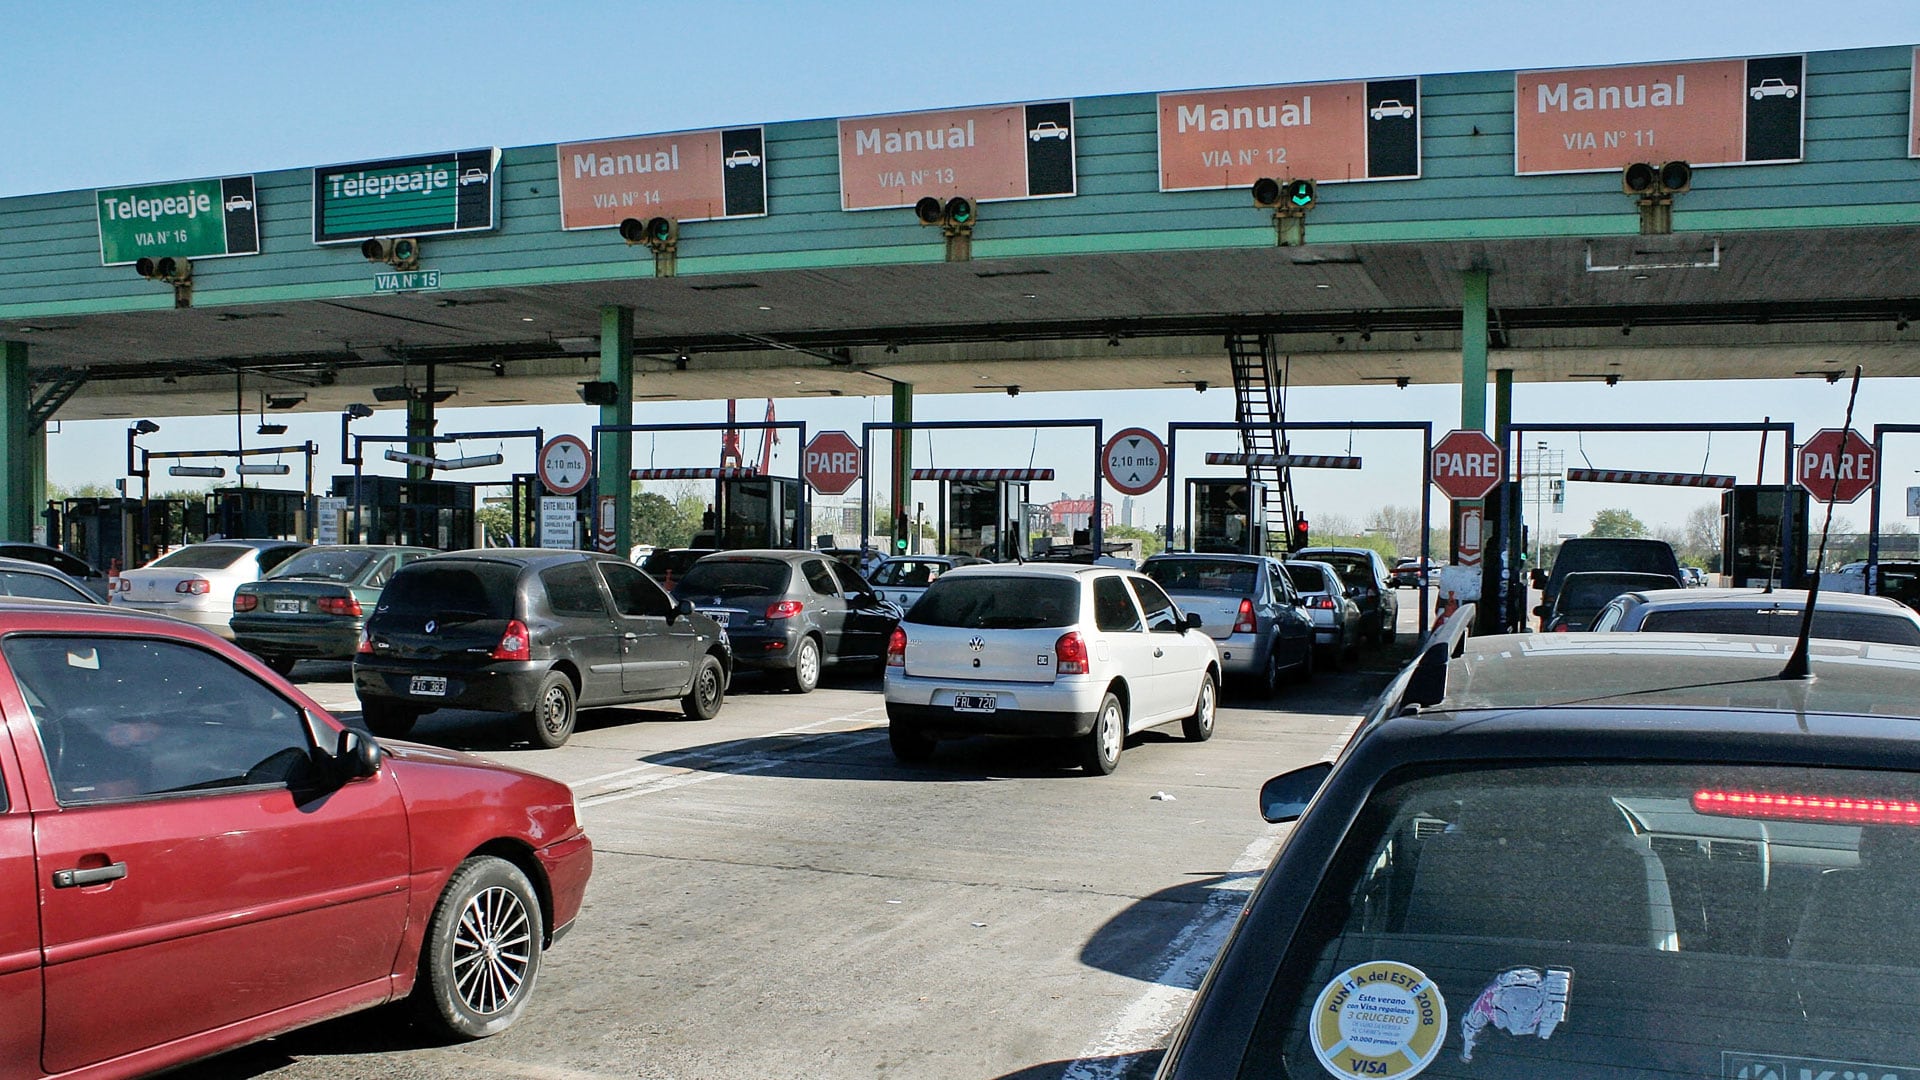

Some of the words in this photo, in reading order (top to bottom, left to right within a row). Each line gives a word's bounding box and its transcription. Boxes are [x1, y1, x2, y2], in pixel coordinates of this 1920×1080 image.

[1537, 75, 1686, 113] Manual
[1177, 96, 1312, 133] Manual
[855, 119, 976, 156] Manual
[1563, 131, 1597, 150] VIA
[1603, 130, 1627, 148] N°
[1634, 129, 1655, 147] 11
[573, 144, 679, 179] Manual
[1201, 150, 1233, 167] VIA
[1239, 148, 1260, 166] N°
[1266, 148, 1287, 164] 12
[328, 165, 449, 199] Telepeaje
[878, 172, 906, 188] VIA
[911, 169, 931, 185] N°
[935, 168, 955, 184] 13
[104, 189, 211, 222] Telepeaje
[593, 194, 619, 209] VIA
[622, 191, 639, 207] N°
[644, 190, 661, 205] 14
[135, 231, 156, 247] VIA
[157, 231, 171, 245] N°
[174, 229, 188, 243] 16
[377, 275, 399, 290] VIA
[402, 275, 418, 288] N°
[422, 273, 437, 287] 15
[546, 459, 565, 470] 2,10
[807, 452, 857, 474] PARE
[1111, 455, 1133, 468] 2,10
[1435, 453, 1497, 477] PARE
[1803, 453, 1871, 480] PARE
[955, 696, 972, 708] FRL
[978, 697, 995, 709] 720
[1328, 976, 1367, 1013] PUNTA
[1368, 971, 1388, 982] del
[1390, 972, 1422, 994] ESTE
[1416, 992, 1434, 1026] 2008
[1358, 994, 1376, 1003] Este
[1378, 997, 1406, 1006] verano
[1360, 1003, 1377, 1011] Visa
[1347, 1011, 1355, 1020] 3
[1356, 1012, 1410, 1025] CRUCEROS
[1350, 1058, 1388, 1075] VISA
